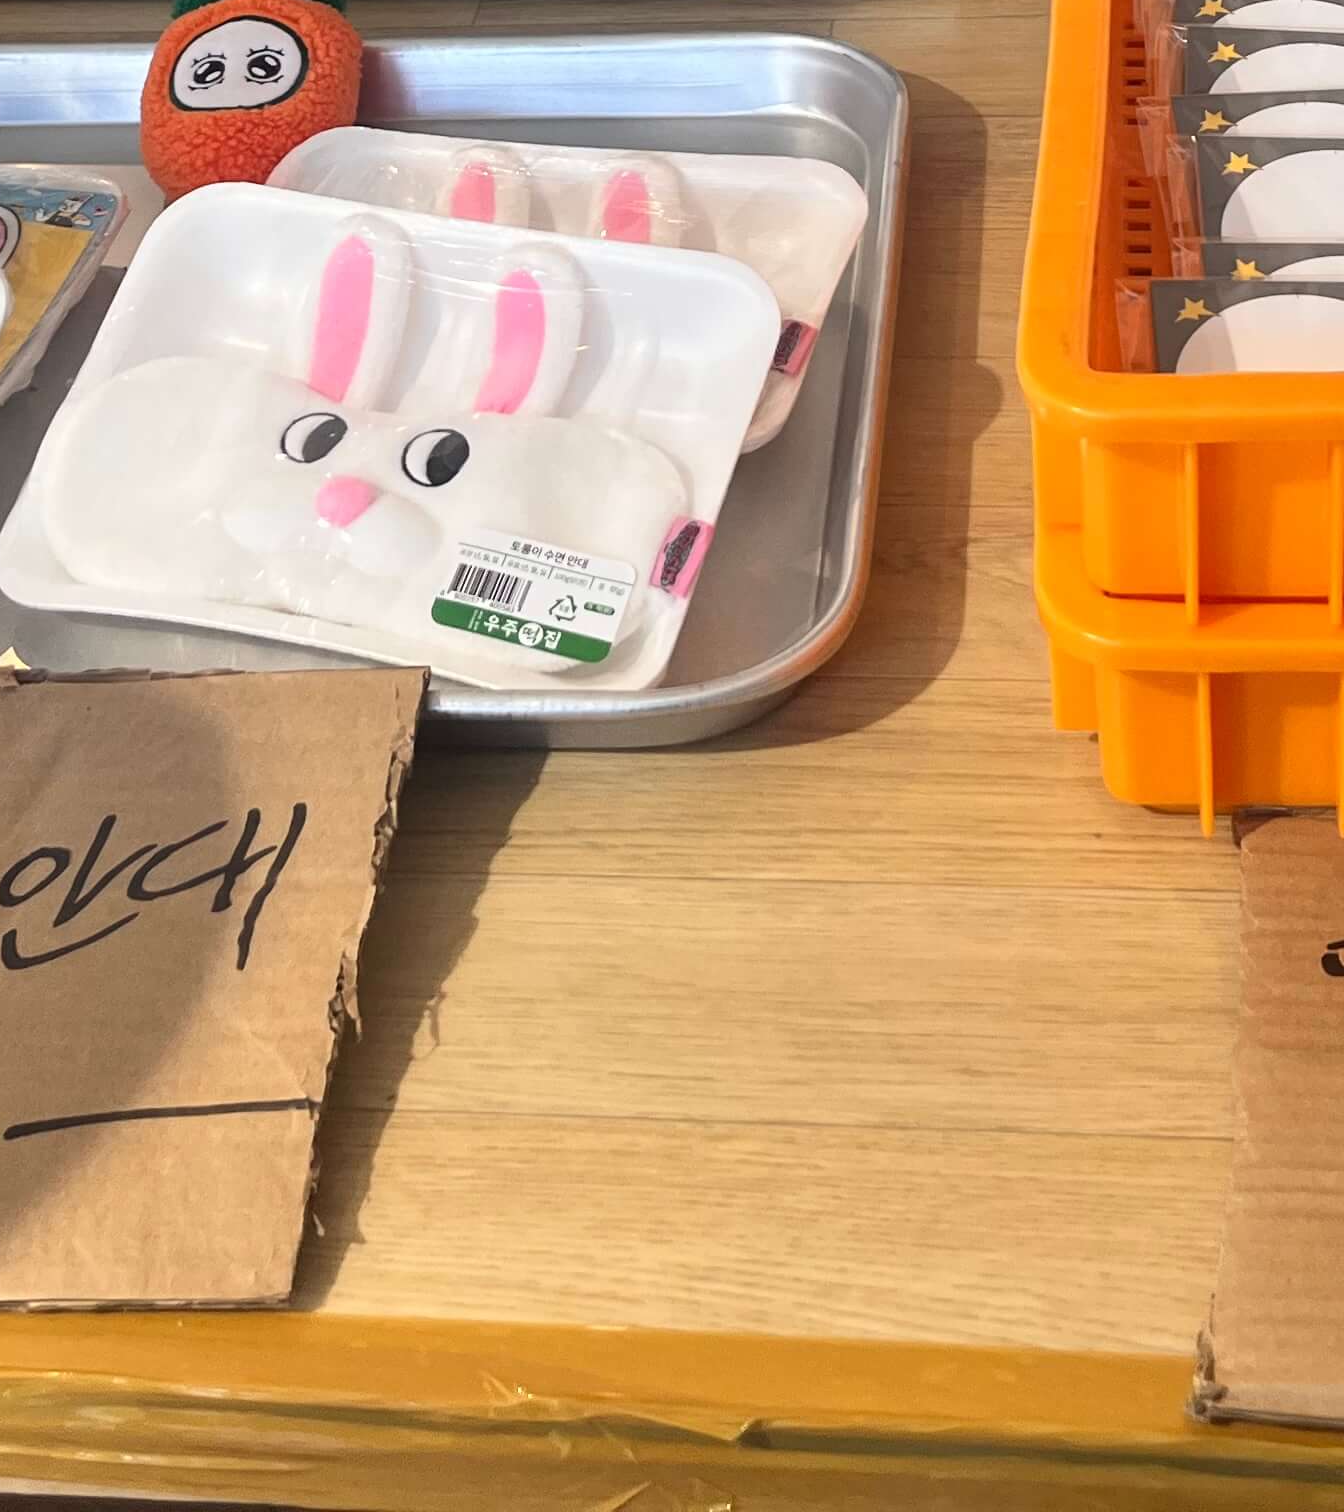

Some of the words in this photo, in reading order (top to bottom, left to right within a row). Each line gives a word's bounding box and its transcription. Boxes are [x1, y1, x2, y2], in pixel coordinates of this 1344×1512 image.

[544, 549, 567, 564] 수면
[567, 554, 590, 570] 안대
[483, 614, 563, 650] 우주떡집
